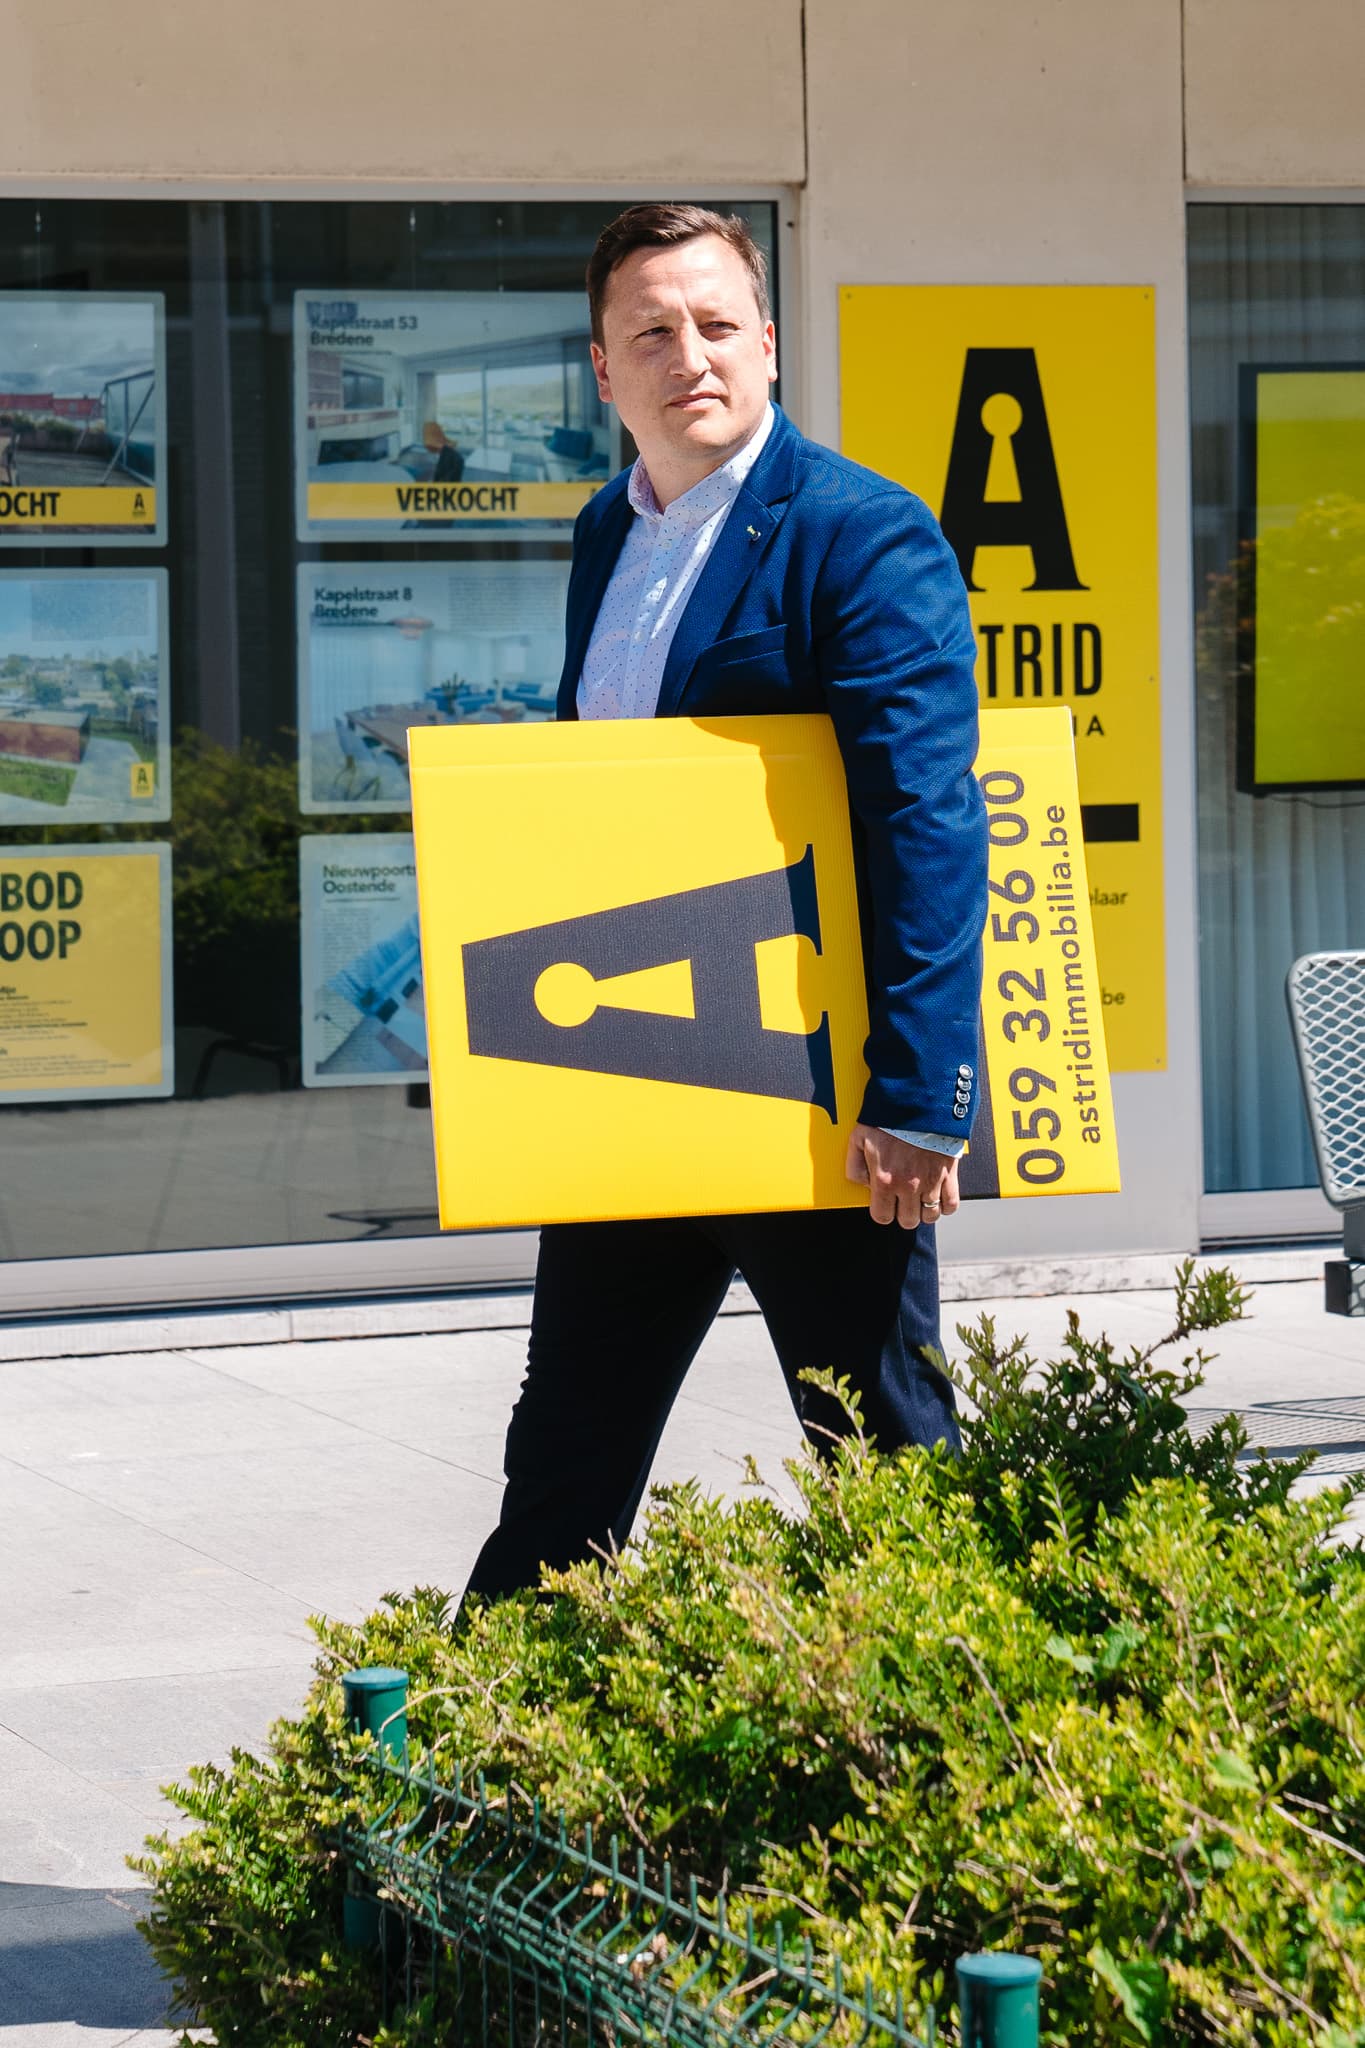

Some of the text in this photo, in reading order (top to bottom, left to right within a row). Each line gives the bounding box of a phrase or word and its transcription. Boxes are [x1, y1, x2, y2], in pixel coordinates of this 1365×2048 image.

[398, 315, 418, 330] 53
[310, 331, 374, 346] Bredene
[939, 347, 1091, 592] A
[396, 487, 520, 512] VERKOCHT
[314, 587, 412, 605] Kapelstraat 8
[314, 603, 379, 618] Bredene
[0, 870, 83, 912] BOD
[323, 879, 396, 893] Oostende
[461, 843, 839, 1125] A
[978, 770, 1066, 1185] 059 32 56 00
[1041, 804, 1102, 1145] astridimmobilia.be
